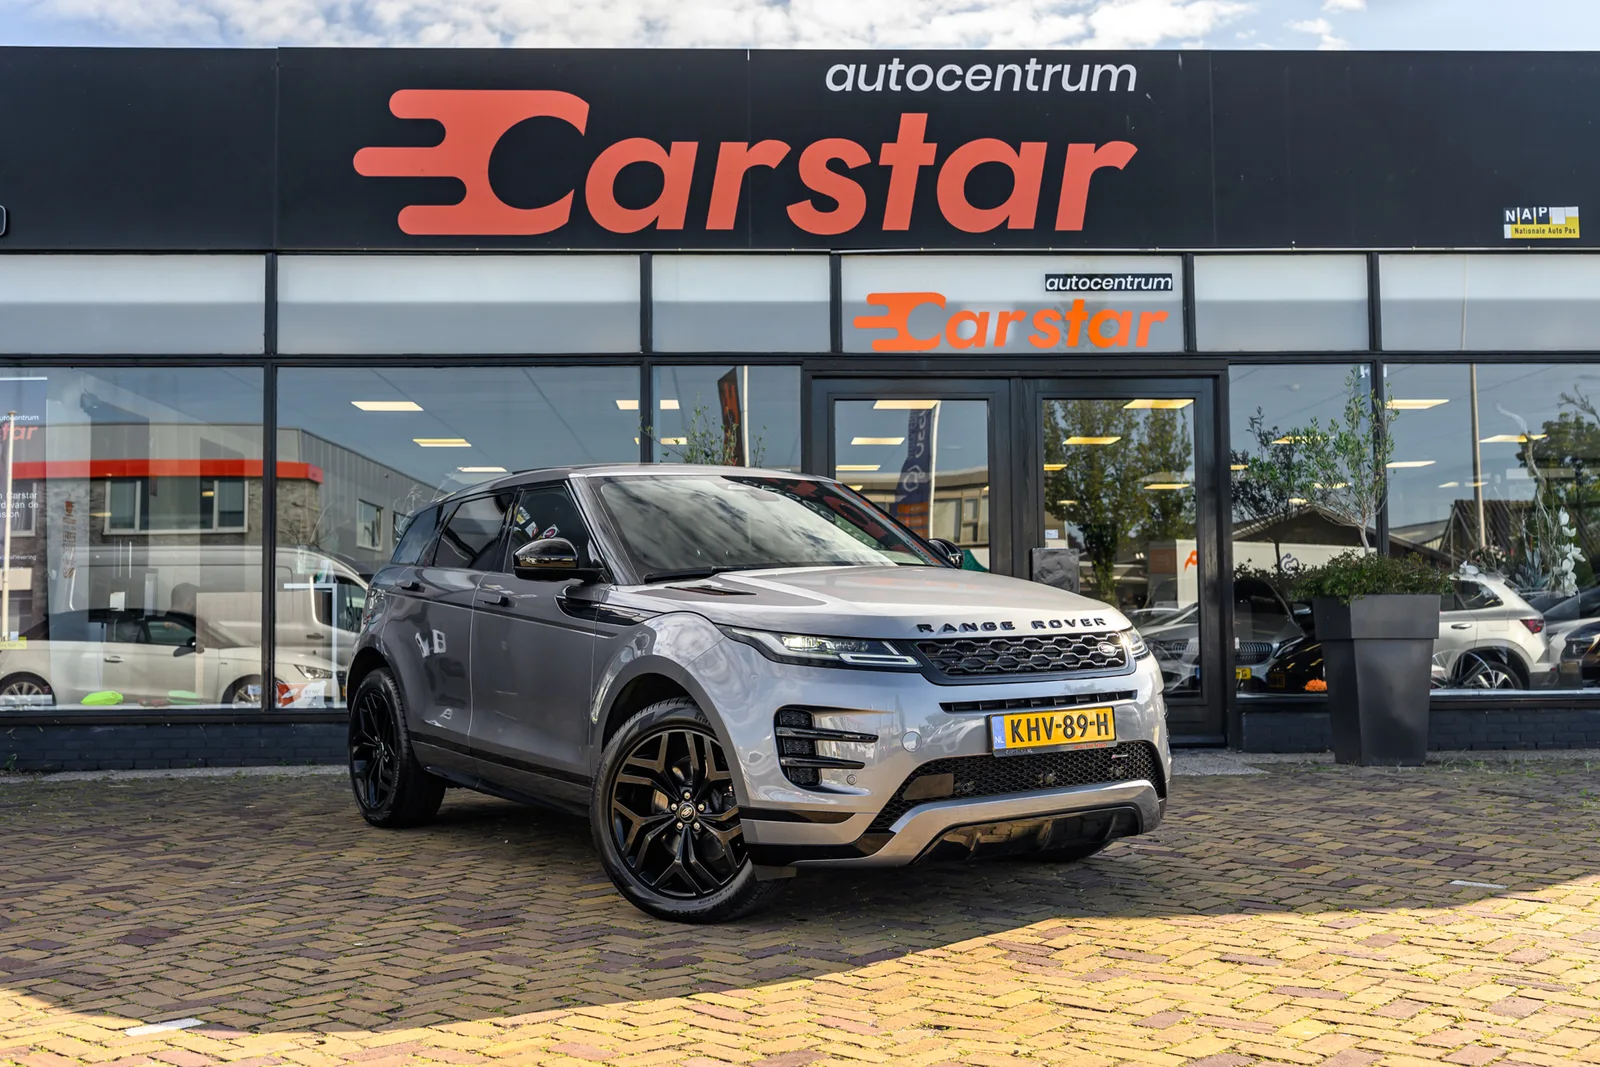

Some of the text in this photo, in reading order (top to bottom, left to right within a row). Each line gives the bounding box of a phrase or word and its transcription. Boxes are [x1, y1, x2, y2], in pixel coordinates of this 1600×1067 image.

[825, 57, 1137, 92] autocentrum
[354, 89, 1138, 236] Carstar
[1548, 226, 1563, 234] Auto
[1564, 226, 1576, 234] Pas
[1045, 274, 1172, 290] autocentrum
[853, 291, 1169, 352] Carstar
[28, 500, 39, 508] de
[917, 617, 1107, 633] RANGE ROVER
[1011, 713, 1109, 743] KHV-89-H
[994, 735, 1005, 744] NL
